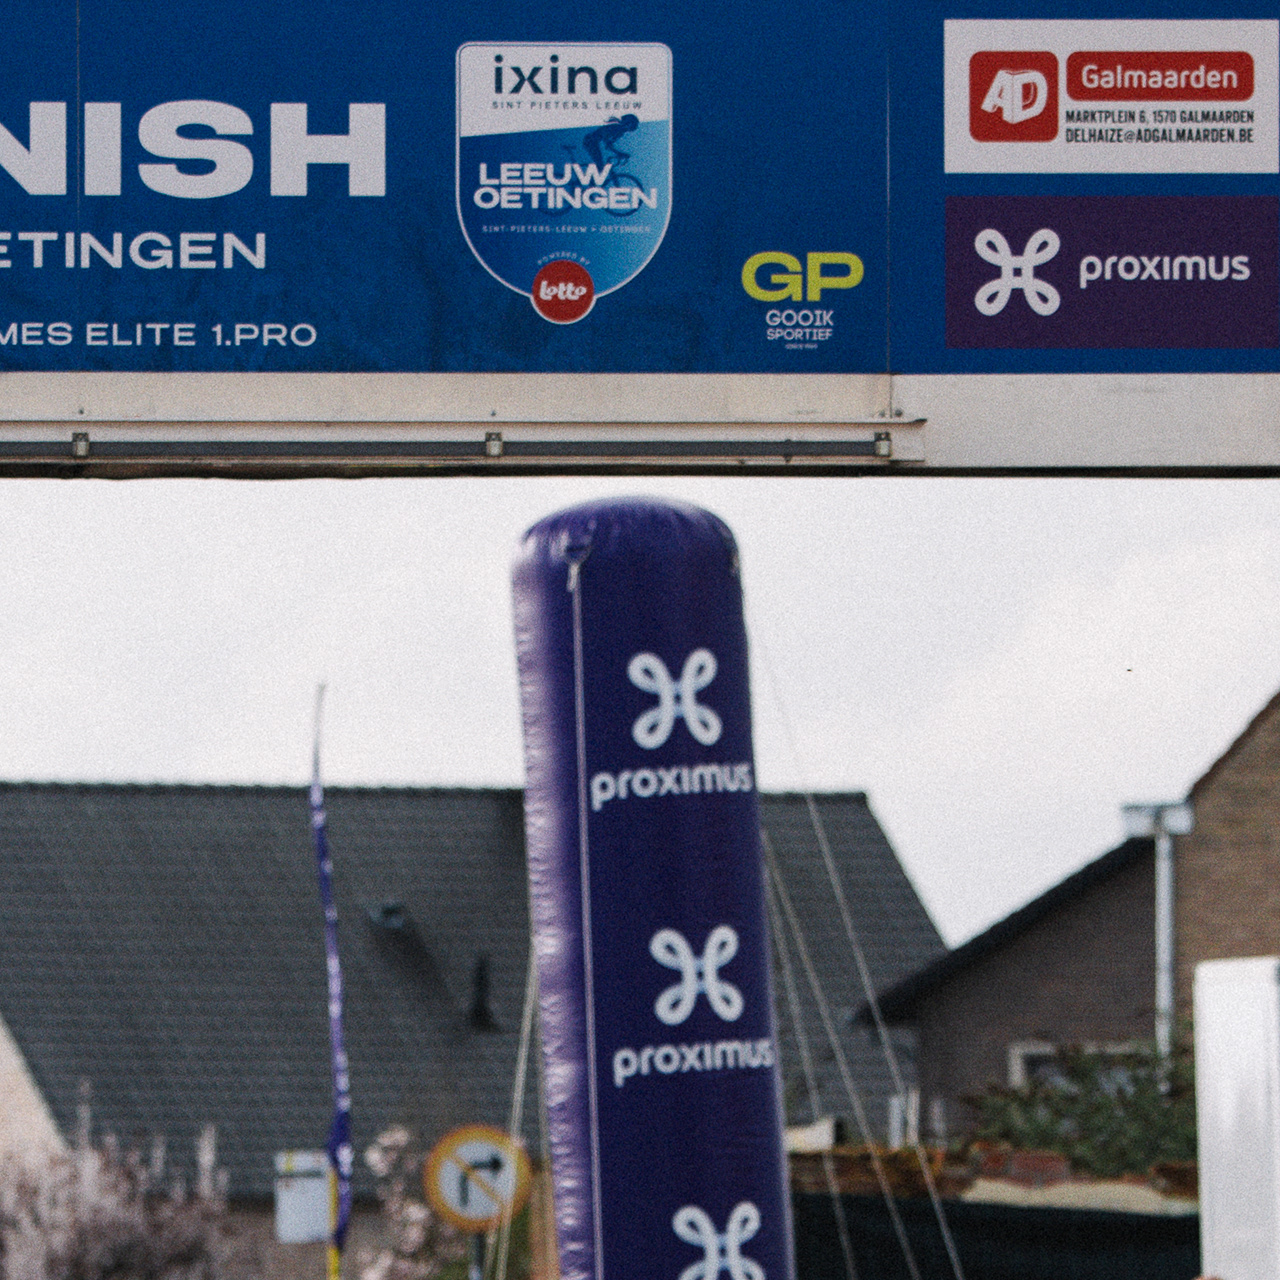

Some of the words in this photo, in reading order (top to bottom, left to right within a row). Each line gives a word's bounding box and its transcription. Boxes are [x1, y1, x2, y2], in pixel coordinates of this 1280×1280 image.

[494, 54, 638, 94] ixina
[1081, 65, 1238, 88] Galmaarden
[491, 101, 522, 109] SINT
[530, 101, 589, 109] PIETERS
[596, 101, 643, 109] LEEUW
[981, 70, 1048, 124] AD
[1066, 110, 1135, 124] MARKTPLEIN
[1153, 110, 1177, 124] 1570
[1180, 110, 1254, 124] GALMAARDEN
[1066, 128, 1254, 143] DELHAIZE@ADGALMAARDEN.BE
[479, 163, 613, 185] LEEUW
[473, 187, 658, 209] OETINGEN
[741, 251, 864, 302] GP
[1080, 252, 1250, 289] proximus
[539, 281, 587, 300] lotto
[765, 309, 834, 326] GOOIK
[86, 322, 196, 346] ELITE
[211, 322, 317, 347] 1.PRO
[766, 328, 833, 340] SPORTIEF
[590, 763, 754, 811] proximus
[613, 1038, 777, 1088] proximus
